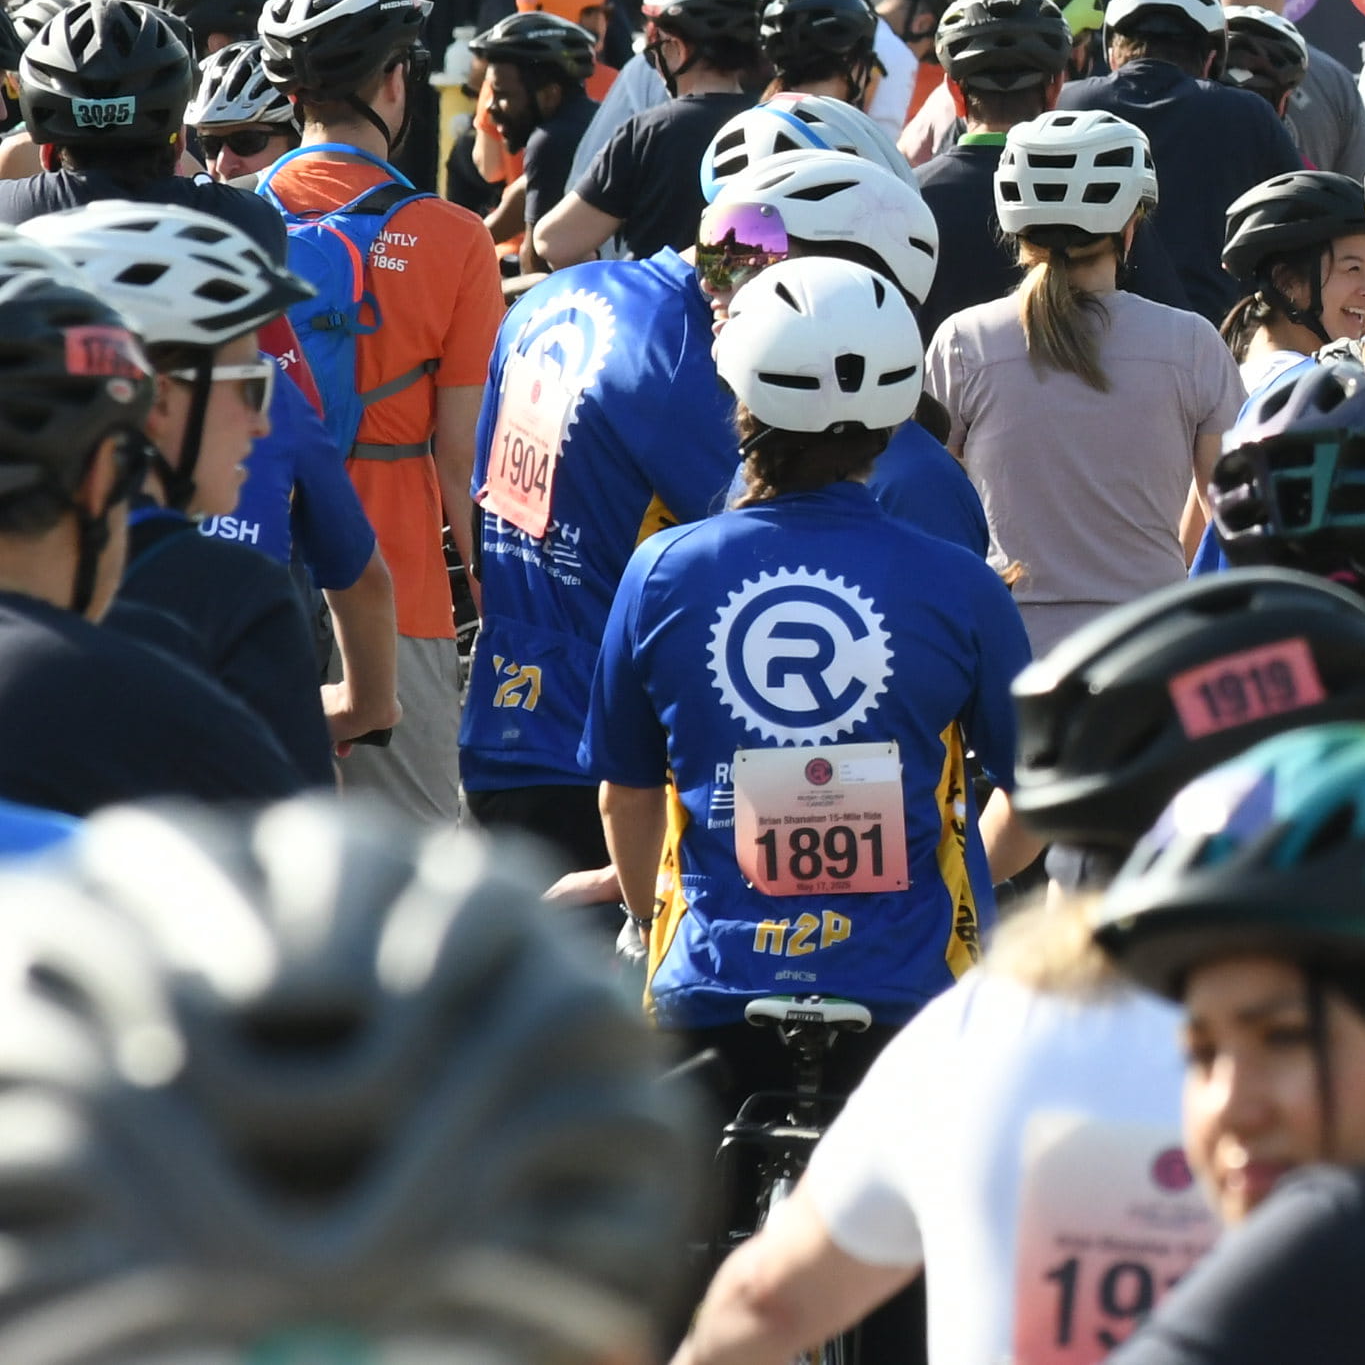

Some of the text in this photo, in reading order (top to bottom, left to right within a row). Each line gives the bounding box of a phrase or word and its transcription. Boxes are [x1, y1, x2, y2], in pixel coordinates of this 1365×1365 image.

[78, 103, 130, 124] 3085
[501, 431, 549, 502] 1904
[1199, 659, 1297, 721] 1919
[758, 816, 782, 826] Brian
[863, 812, 882, 821] Ride
[755, 823, 884, 881] 1891
[1043, 1255, 1180, 1352] 19
